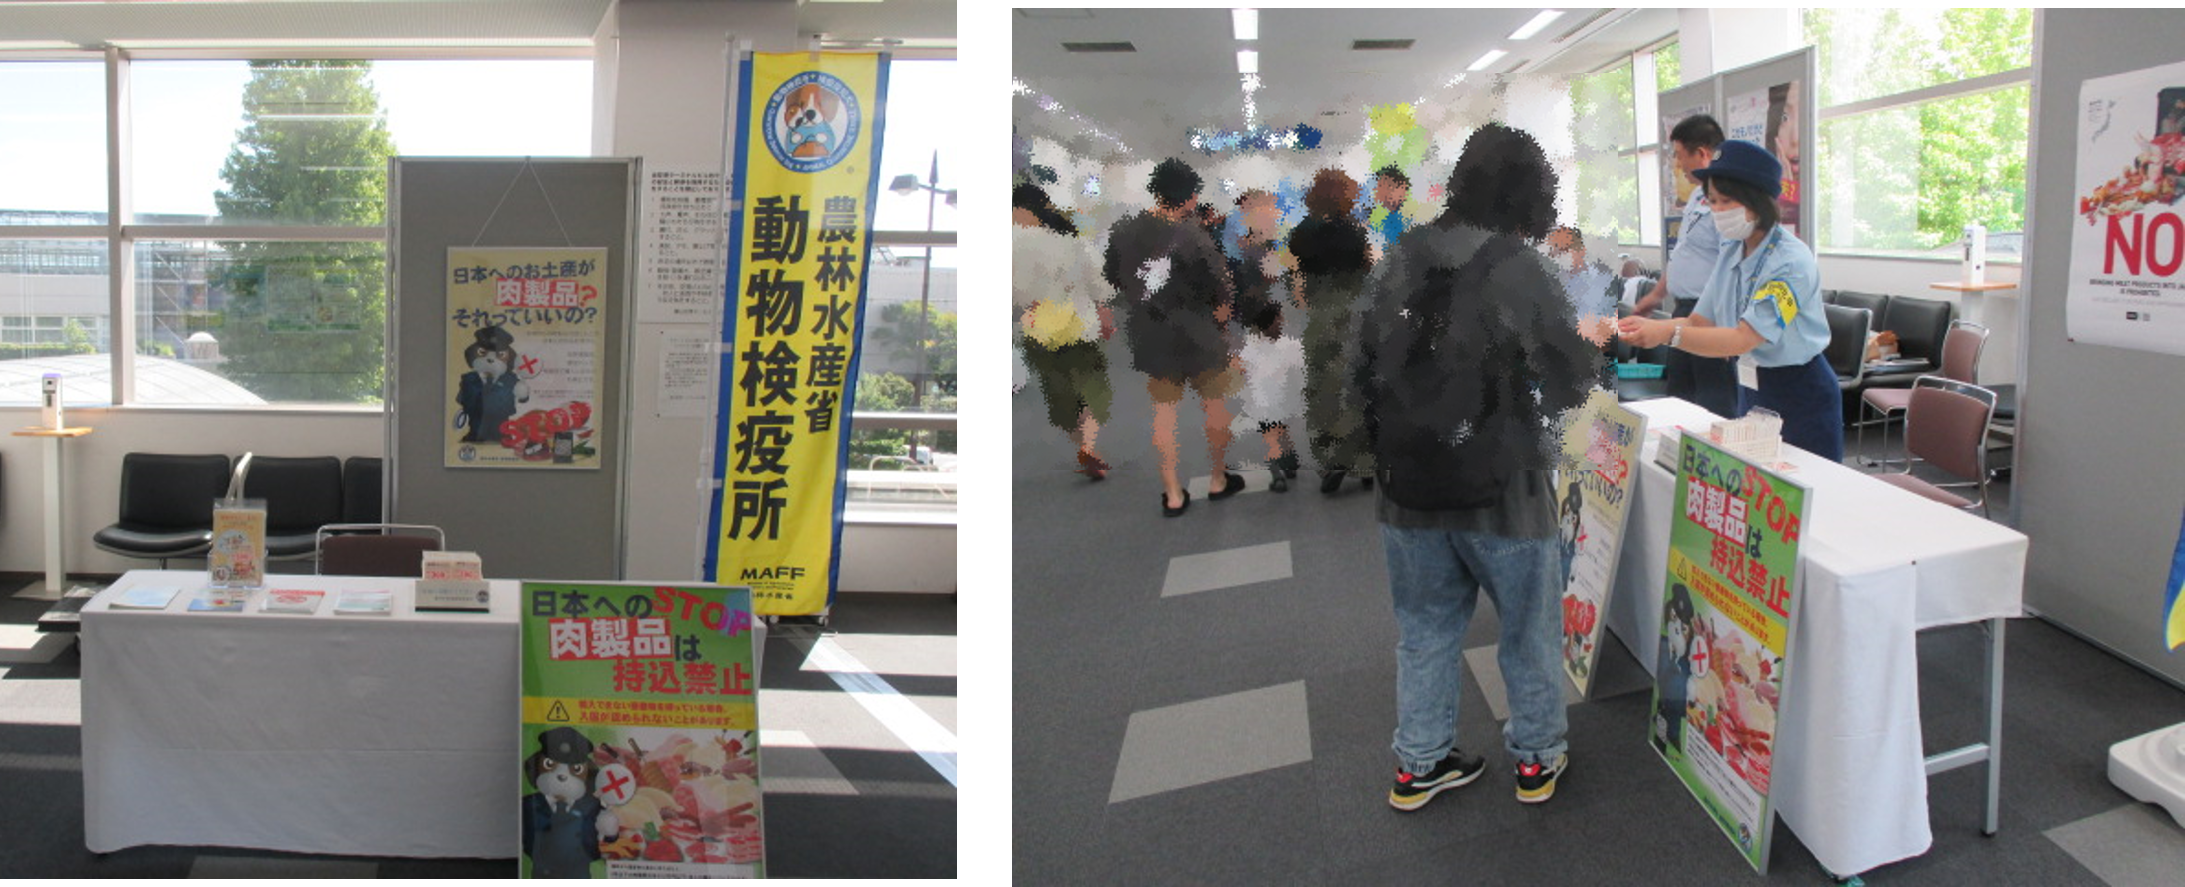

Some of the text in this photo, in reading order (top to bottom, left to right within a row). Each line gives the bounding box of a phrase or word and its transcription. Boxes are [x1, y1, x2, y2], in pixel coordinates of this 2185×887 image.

[453, 259, 596, 284] 日本へのお土産が
[452, 307, 597, 327] それっていいの?
[804, 195, 857, 433] 農林水産省
[727, 195, 810, 540] 動物検疫所
[1683, 444, 1741, 497] 日本への
[1743, 465, 1800, 544] STOP
[740, 566, 805, 580] MAFF
[1710, 535, 1790, 618] 持込禁止
[532, 586, 752, 637] 日本への STOP
[612, 660, 753, 696] 持込禁止
